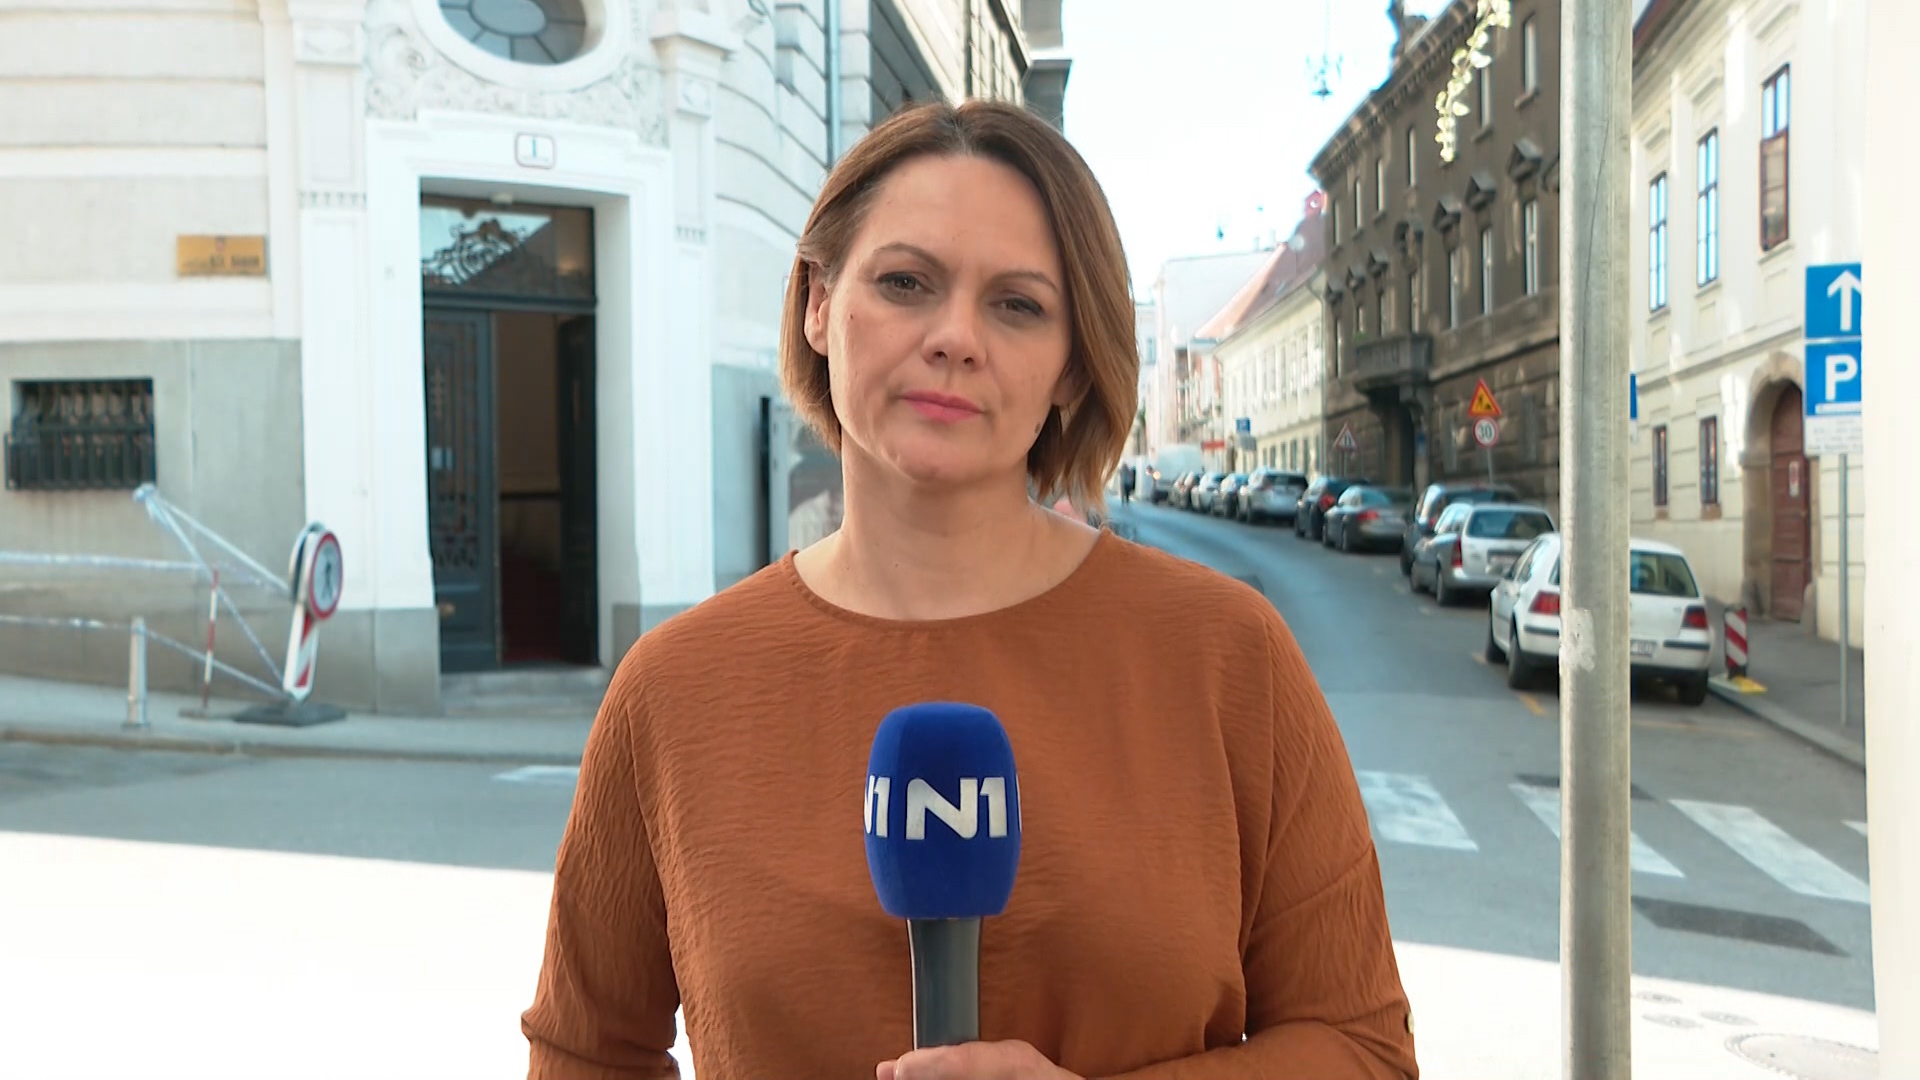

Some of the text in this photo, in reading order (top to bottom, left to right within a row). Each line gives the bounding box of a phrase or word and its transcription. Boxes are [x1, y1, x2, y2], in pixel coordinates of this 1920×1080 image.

[1825, 354, 1858, 402] P
[1477, 422, 1493, 440] 30
[906, 777, 1008, 840] N1
